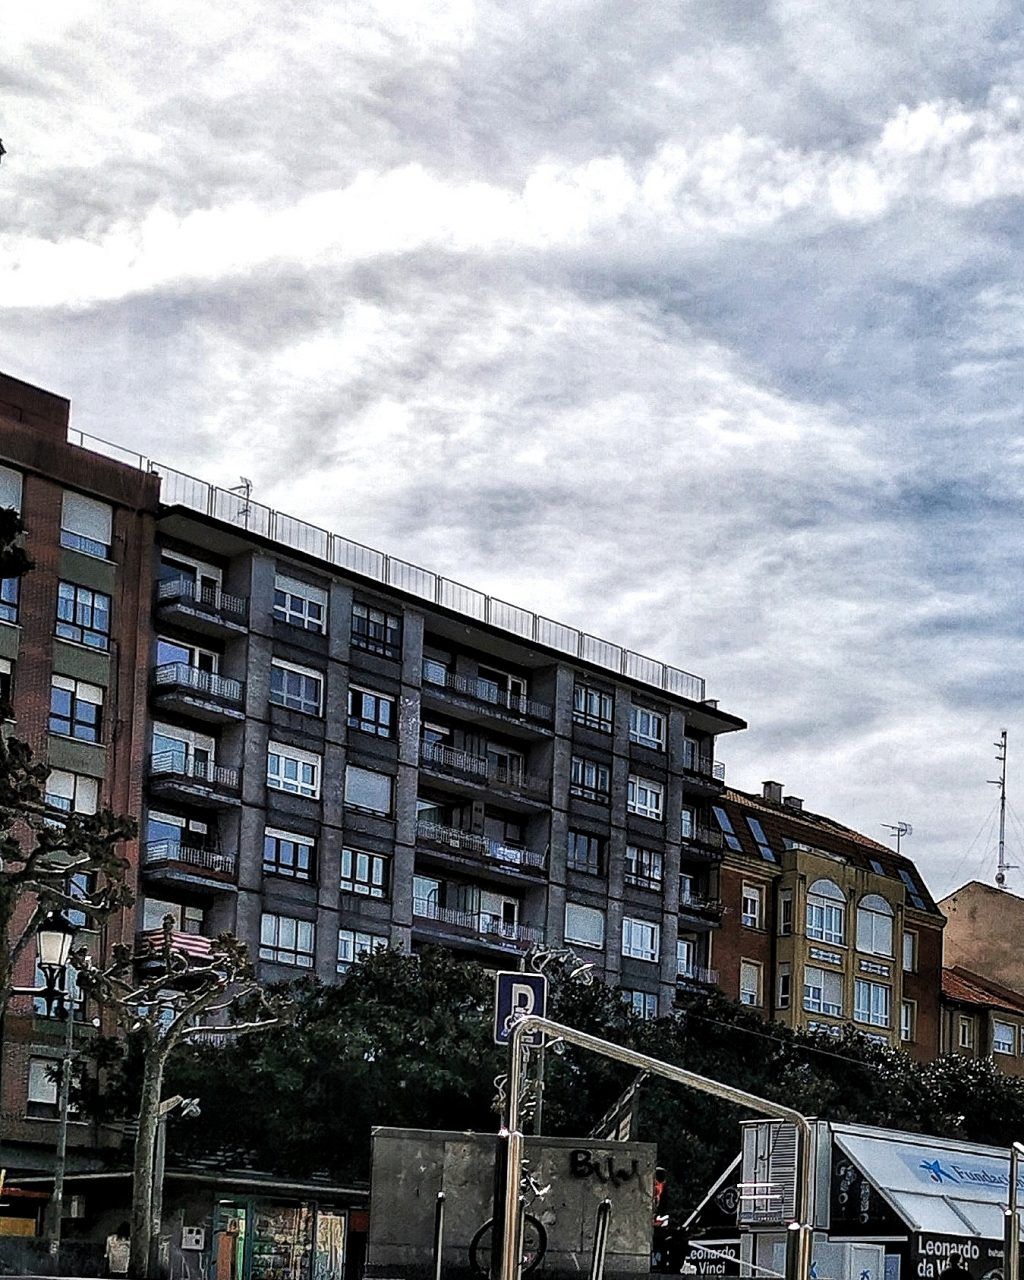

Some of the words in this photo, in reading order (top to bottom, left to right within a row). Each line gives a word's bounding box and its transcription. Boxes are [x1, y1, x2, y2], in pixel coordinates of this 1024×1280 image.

[918, 1235, 980, 1260] Leonardo
[699, 1261, 726, 1275] Vinci
[917, 1258, 934, 1278] da
